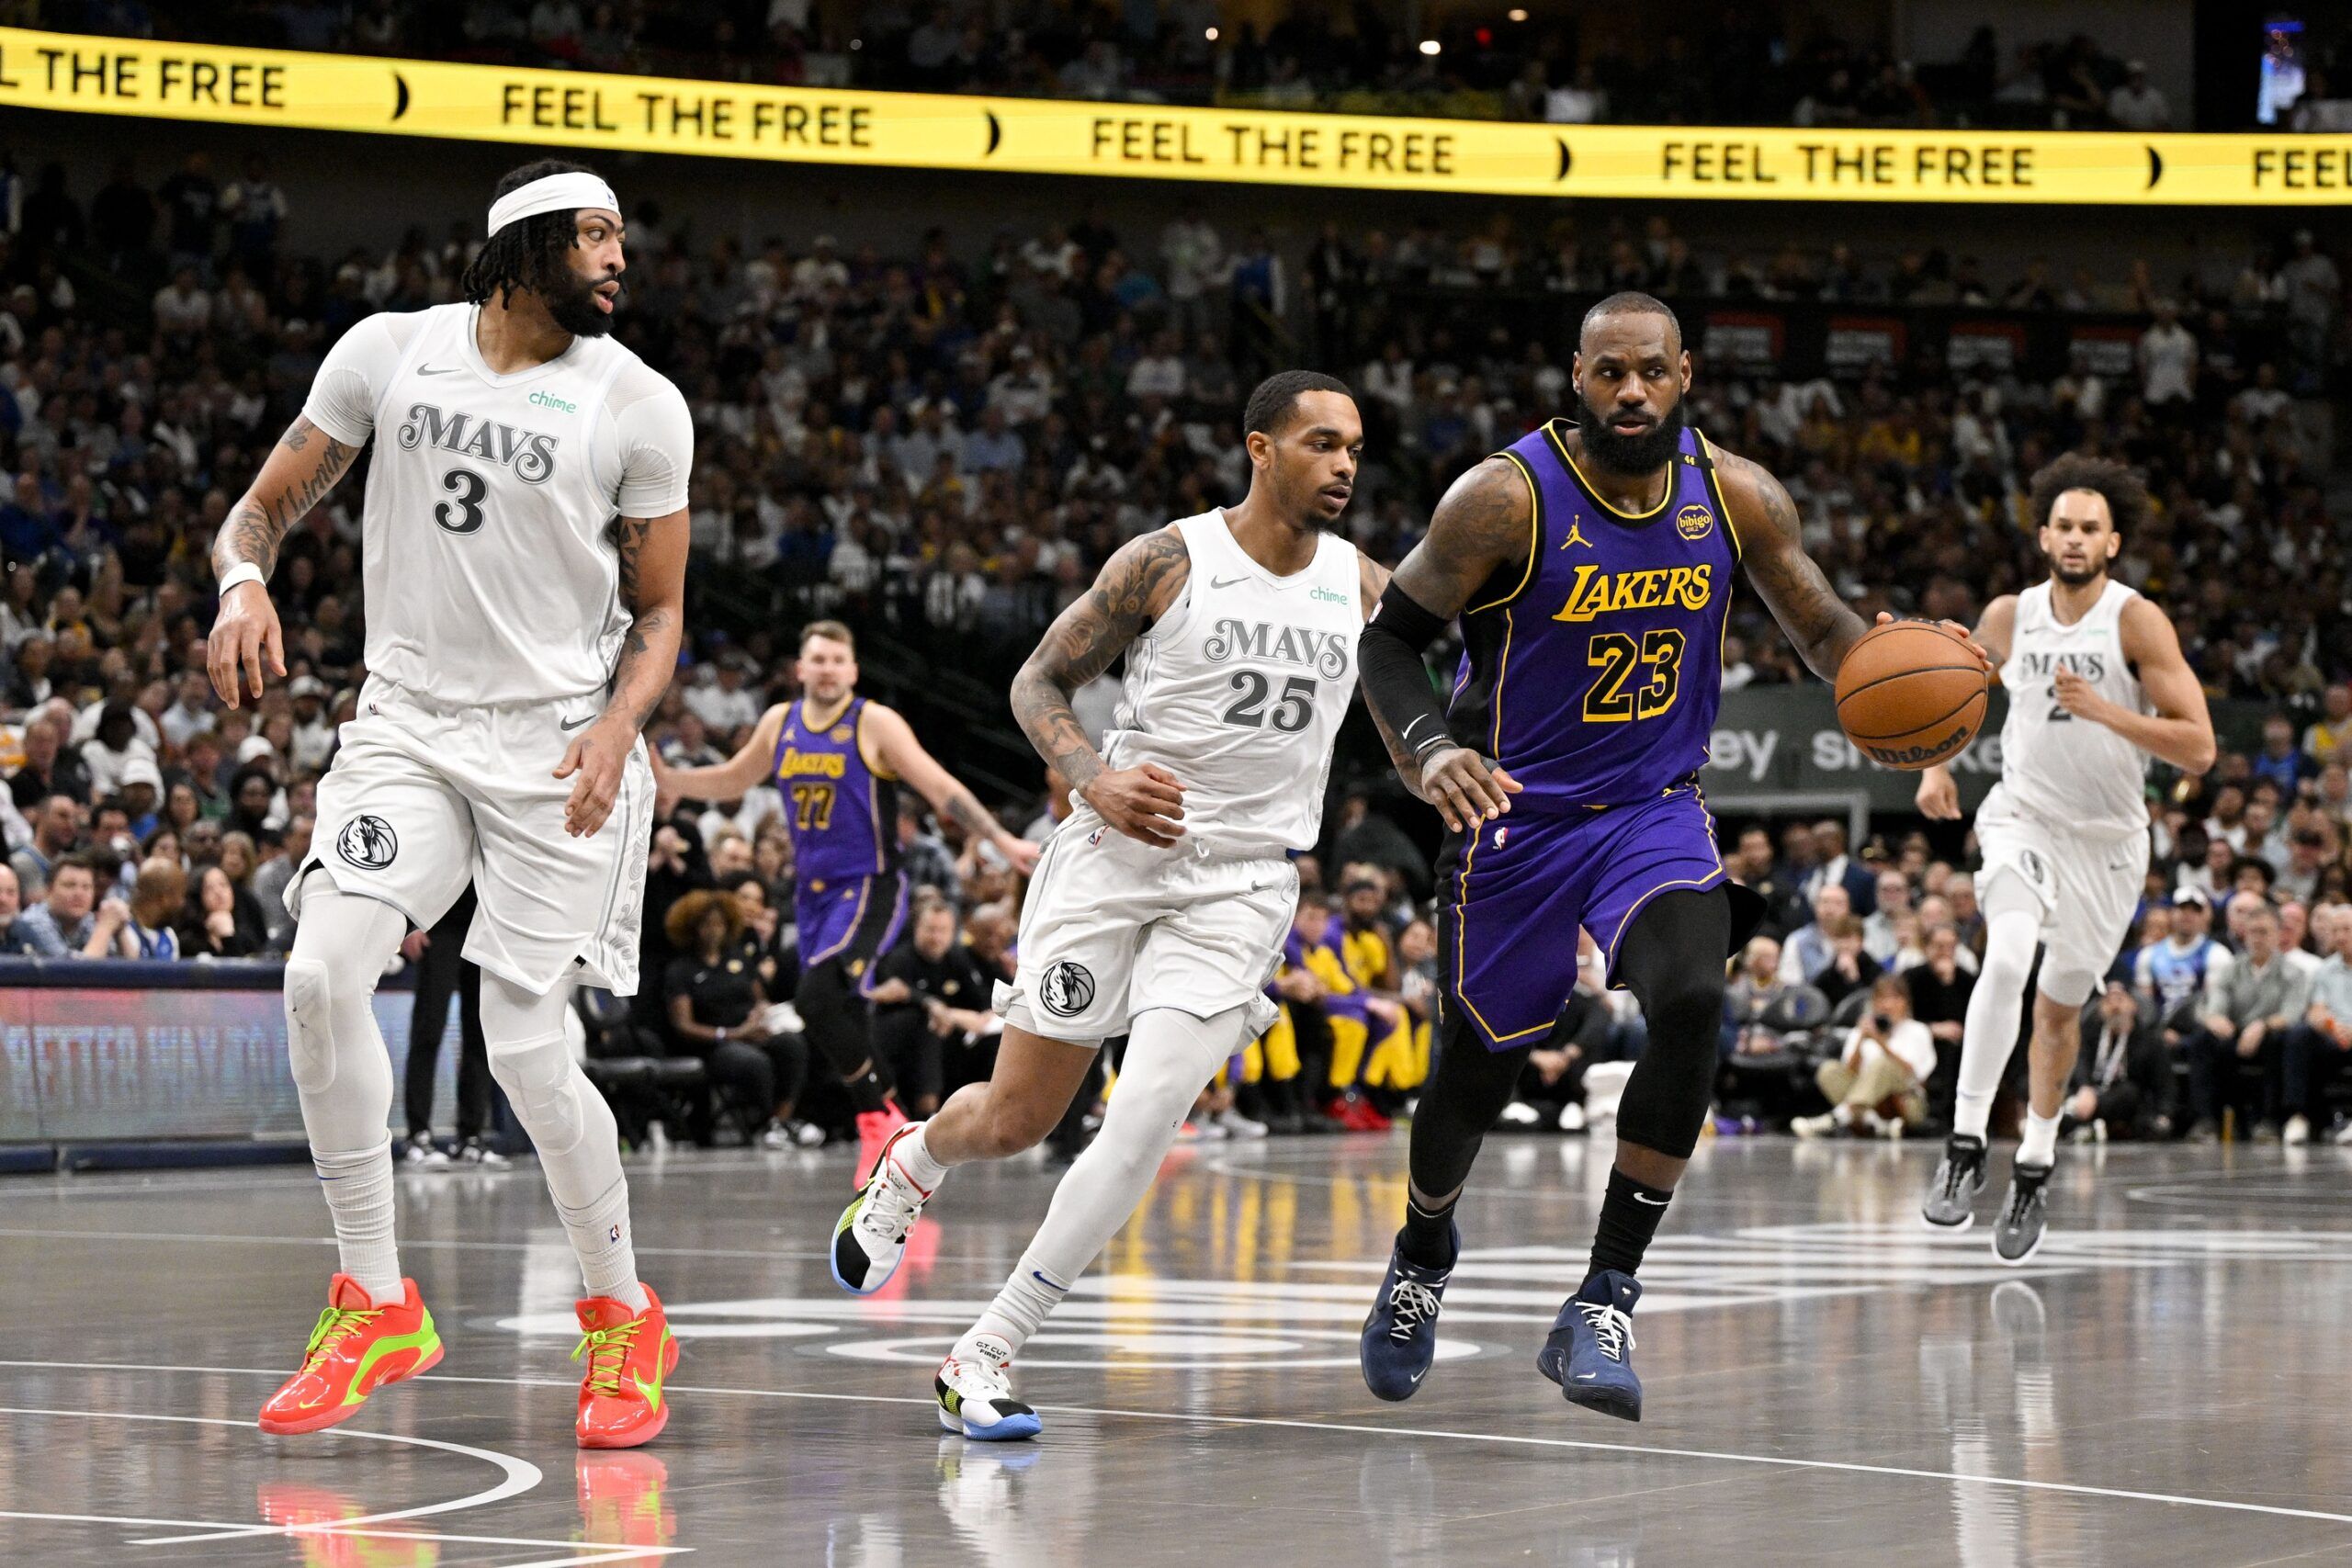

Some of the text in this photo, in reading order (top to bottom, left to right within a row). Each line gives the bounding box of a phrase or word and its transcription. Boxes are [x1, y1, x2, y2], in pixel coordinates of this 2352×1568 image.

[36, 48, 139, 97] THE
[160, 58, 285, 108] FREE
[503, 84, 870, 148] FEEL THE FREE
[1092, 118, 1453, 175] FEEL THE FREE
[1664, 143, 2033, 186] FEEL THE FREE
[528, 390, 577, 413] chime
[396, 401, 560, 485] MAVS
[433, 468, 489, 536] 3
[1679, 514, 1710, 528] bibigo
[1309, 586, 1348, 605] chime
[1551, 564, 1712, 623] LAKERS
[1202, 618, 1349, 682] MAVS
[1582, 628, 1687, 723] 23
[1221, 668, 1318, 735] 25
[1866, 726, 1968, 764] Wilson
[791, 782, 836, 830] 77
[979, 1348, 1001, 1360] FIRST
[990, 1347, 1007, 1357] CUT
